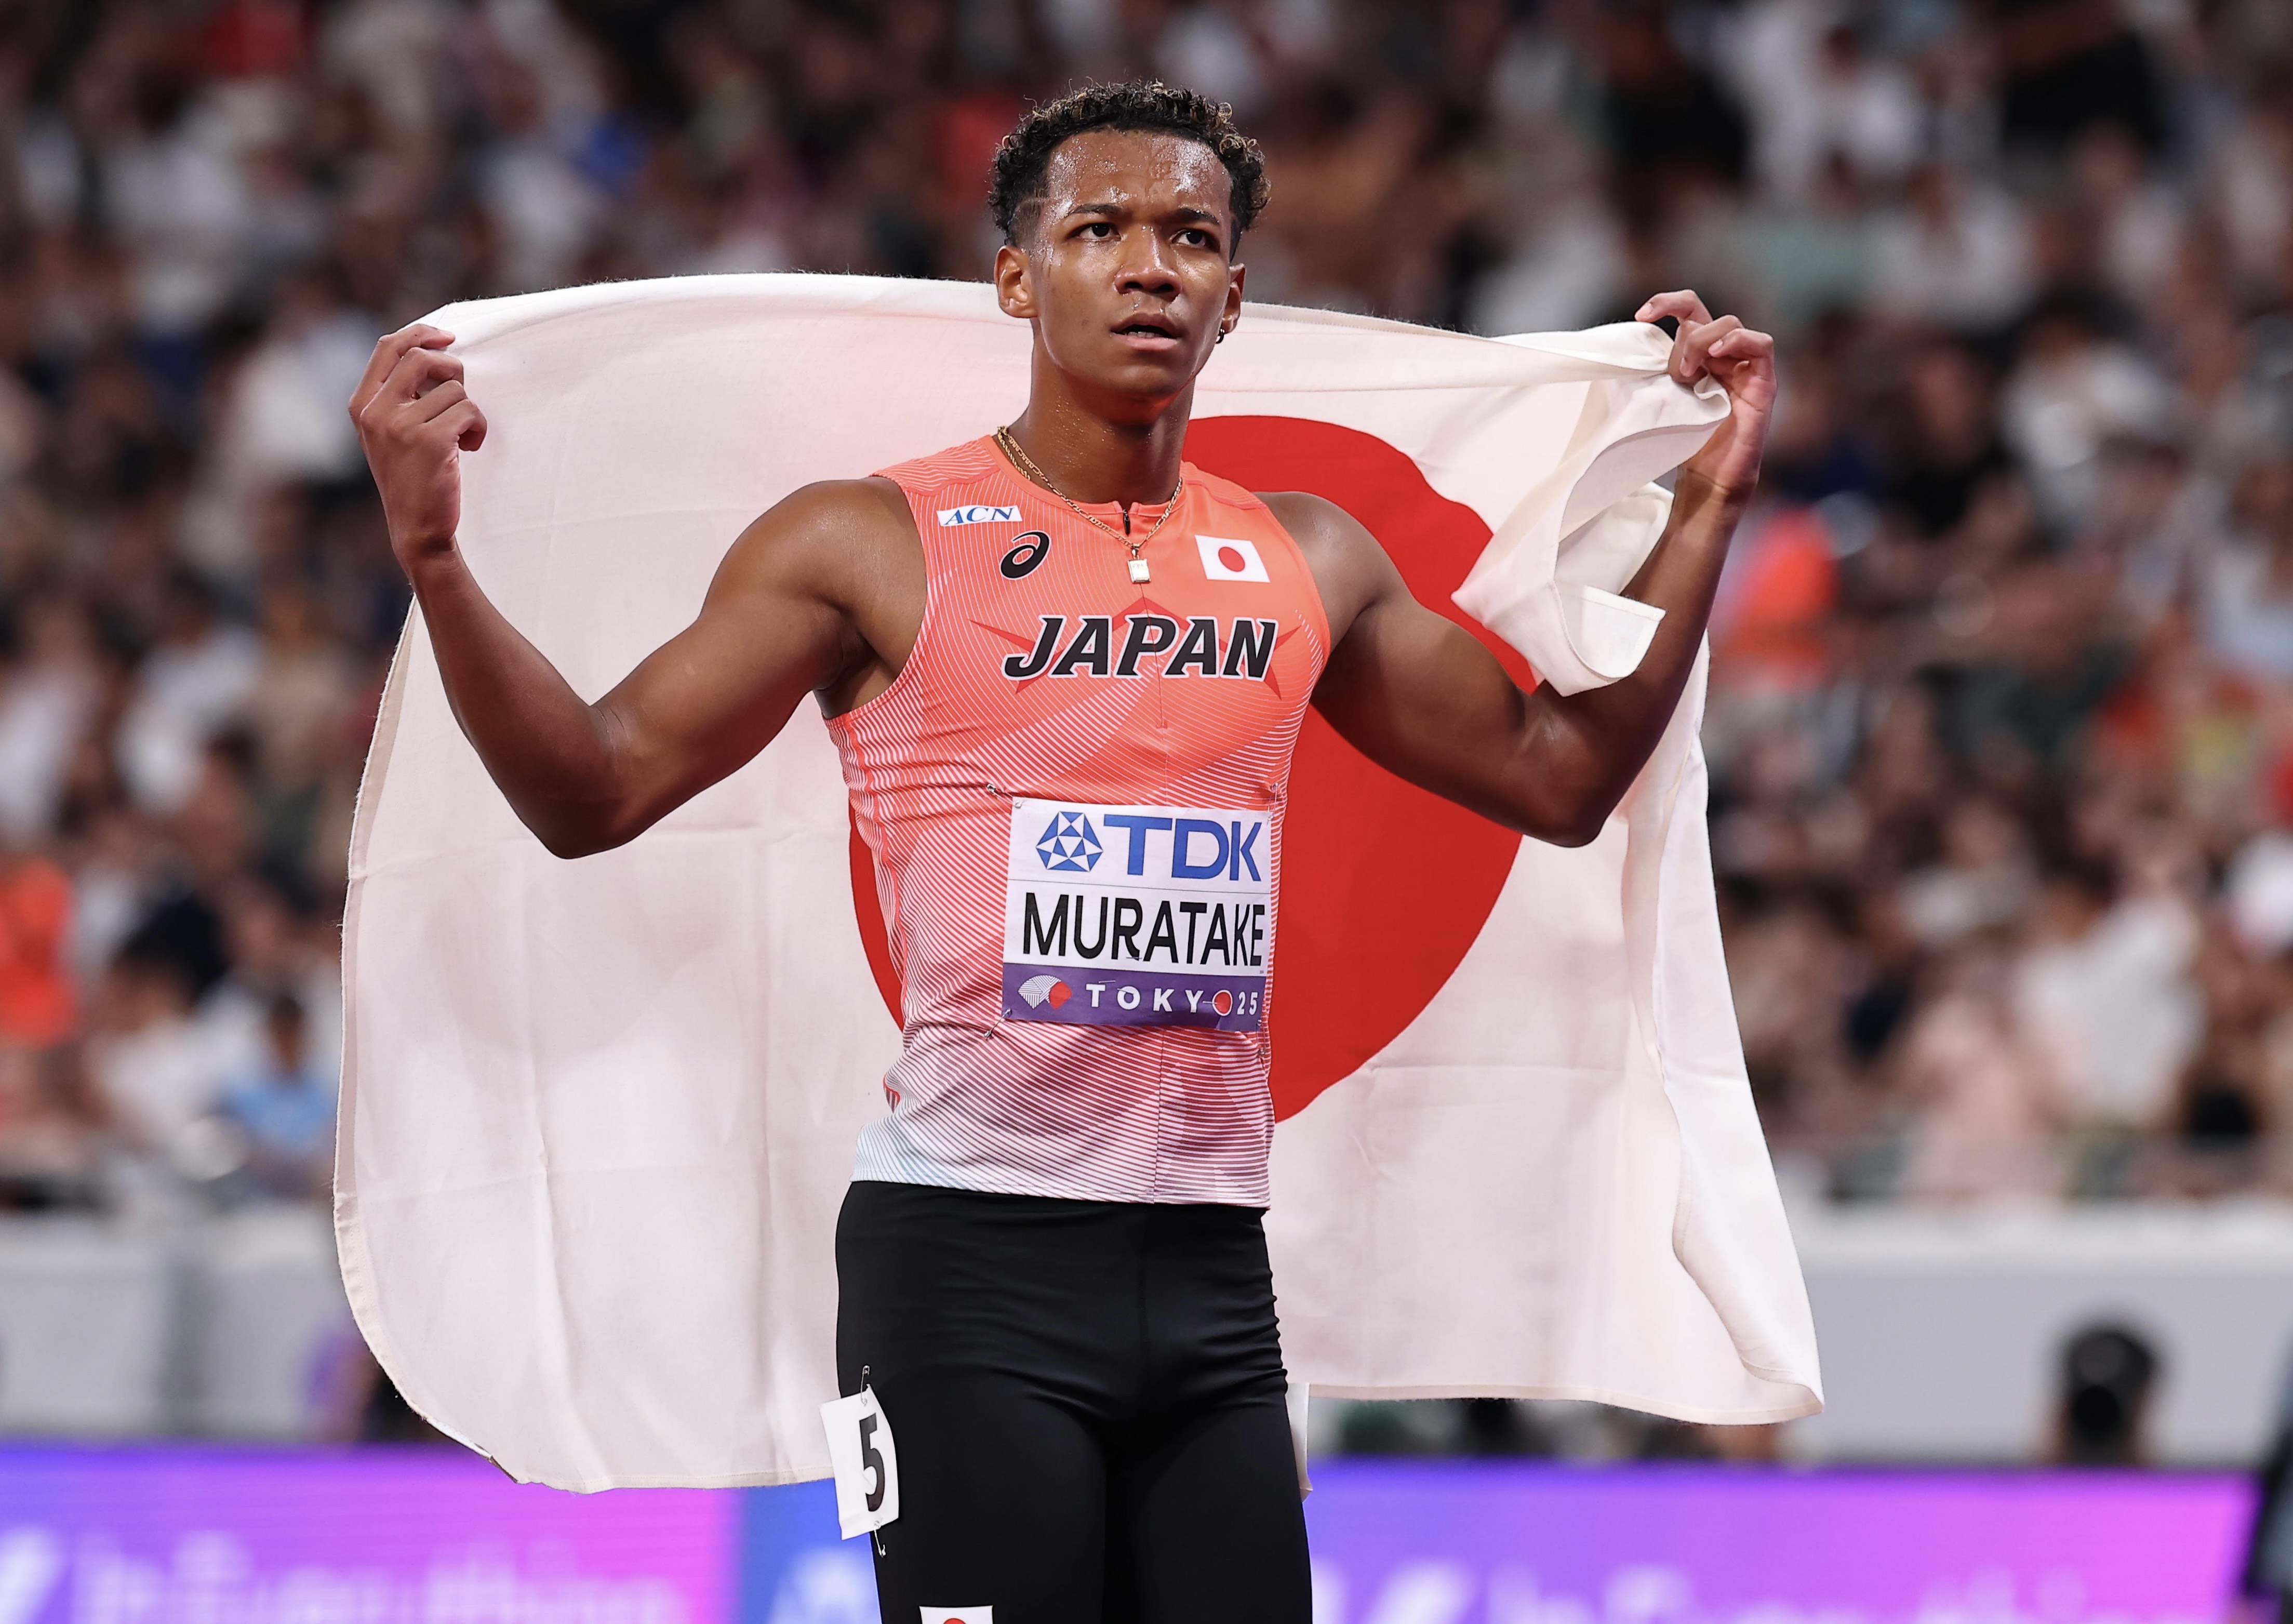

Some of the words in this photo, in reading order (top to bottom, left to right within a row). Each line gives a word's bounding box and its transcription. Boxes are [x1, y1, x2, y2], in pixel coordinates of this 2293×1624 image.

[945, 507, 1015, 525] ACN
[1003, 614, 1278, 680] JAPAN
[1103, 814, 1262, 882] TDK
[1023, 892, 1265, 966] MURATAKE
[859, 1413, 885, 1512] 5
